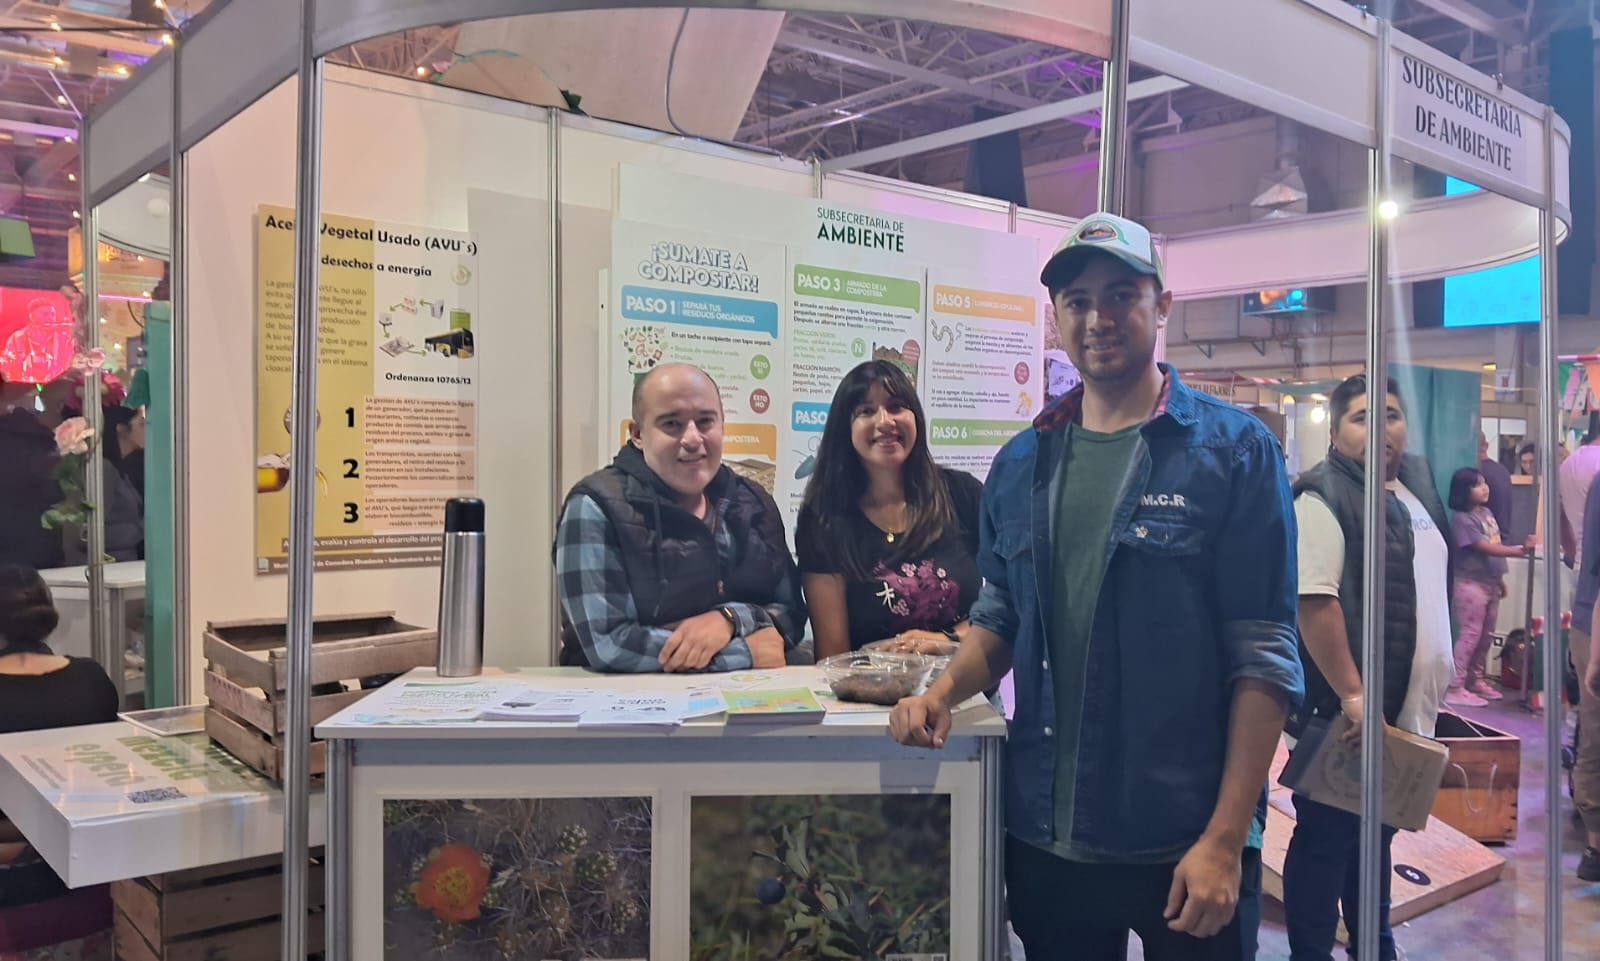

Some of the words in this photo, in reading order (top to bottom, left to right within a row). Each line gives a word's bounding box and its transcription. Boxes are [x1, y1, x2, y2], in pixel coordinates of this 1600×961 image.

[1415, 105, 1437, 139] DE
[1440, 118, 1512, 171] AMBIENTE
[817, 206, 890, 230] SUBSECRETARIA
[893, 221, 904, 233] DE
[265, 215, 294, 230] Ace
[378, 230, 421, 247] Usado
[817, 222, 904, 253] AMBIENTE
[321, 255, 373, 270] desechos
[377, 264, 384, 272] a
[388, 263, 432, 277] energía
[651, 241, 731, 269] ¡SUMATE
[733, 253, 748, 271] A
[638, 260, 759, 293] COMPOSTAR!
[797, 273, 831, 290] PASO
[833, 278, 841, 292] 3
[626, 296, 667, 313] PASO
[669, 299, 676, 315] 1
[936, 292, 963, 306] PASO
[964, 295, 971, 309] 5
[385, 372, 434, 382] Ordenanza
[345, 407, 355, 427] 1
[796, 410, 827, 424] PASO
[932, 426, 960, 439] PASO
[961, 426, 968, 439] 6
[343, 458, 359, 479] 2
[1141, 494, 1186, 507] M.C.R
[343, 502, 359, 523] 3
